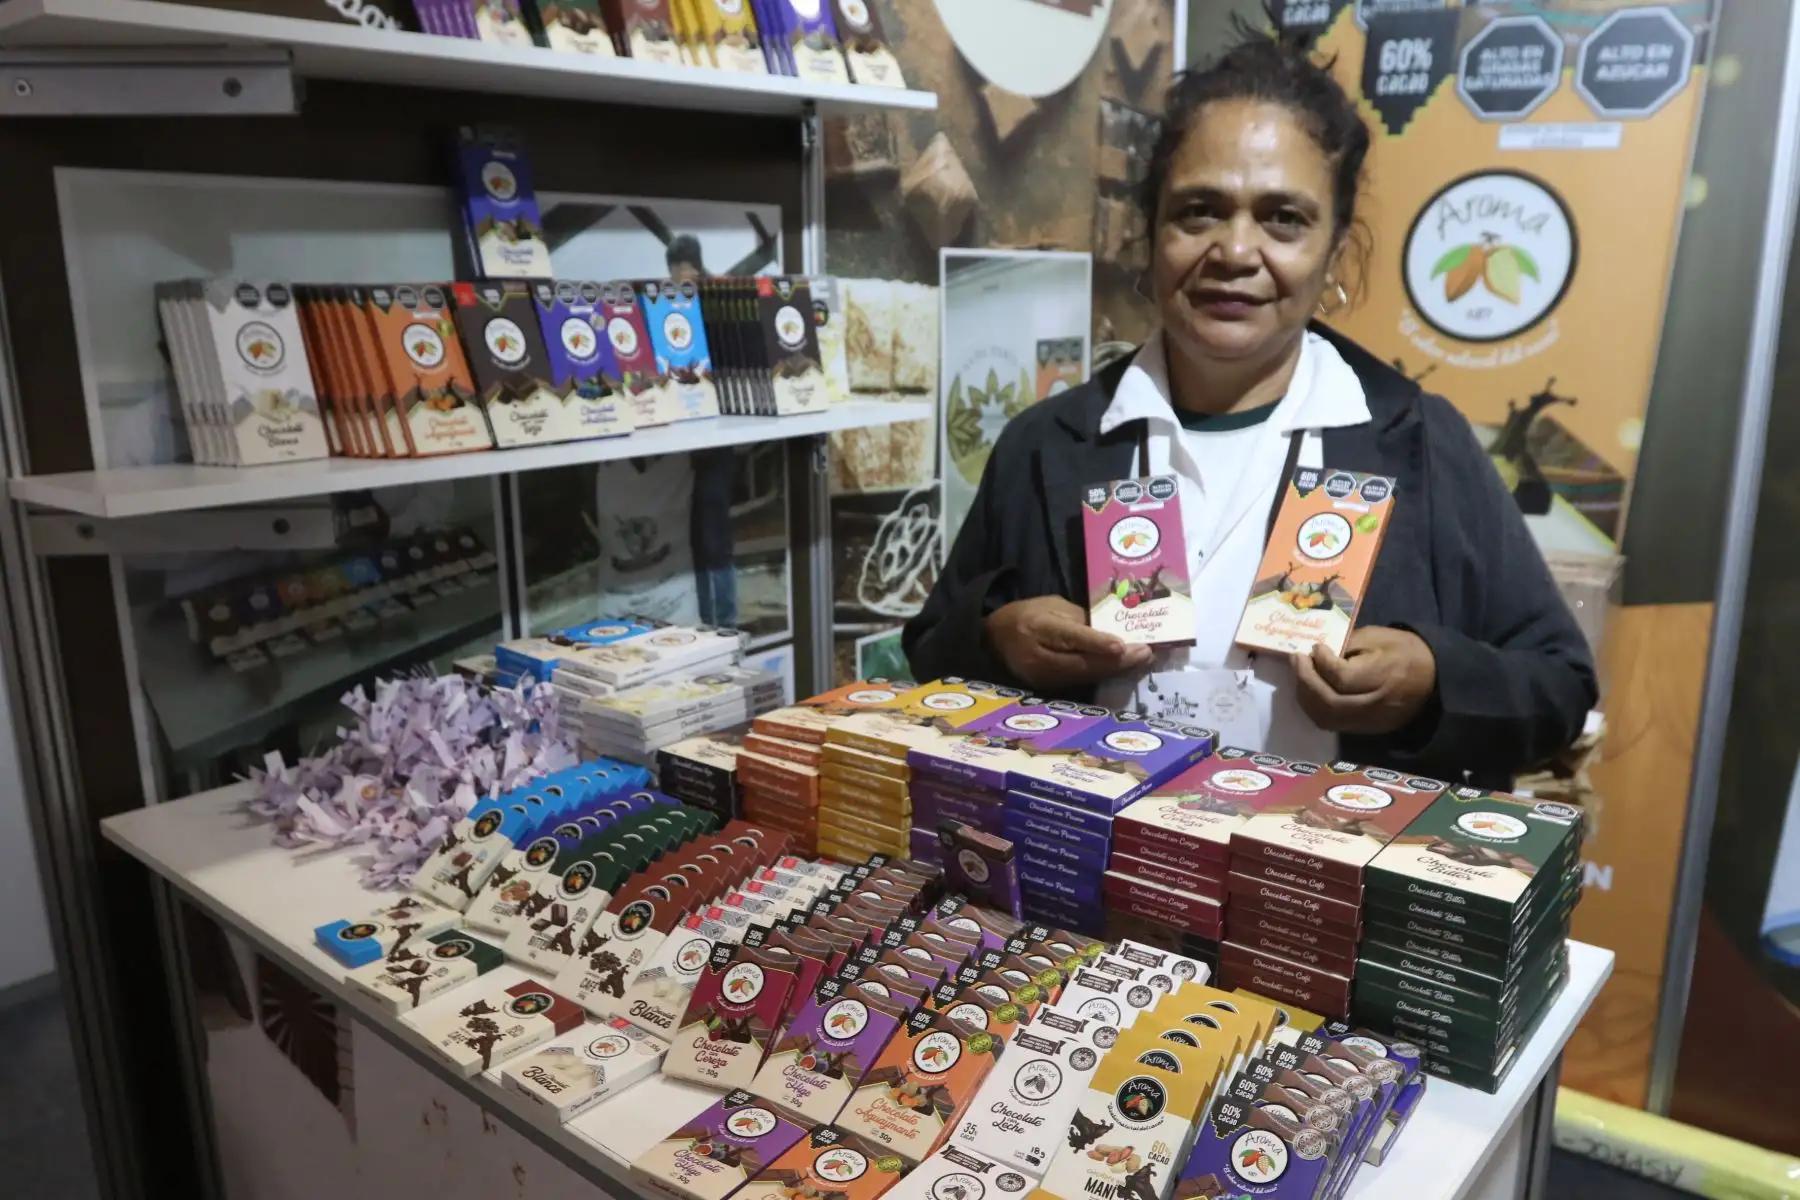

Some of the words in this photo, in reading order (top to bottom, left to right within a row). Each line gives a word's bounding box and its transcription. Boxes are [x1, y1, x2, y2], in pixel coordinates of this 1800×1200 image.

[1379, 38, 1433, 72] 60%
[1598, 46, 1643, 61] ALTO
[1437, 194, 1551, 241] Aroma
[1264, 847, 1294, 861] Chocolate
[1265, 867, 1296, 881] Chocolate
[1260, 887, 1290, 901] Chocolate
[1408, 883, 1443, 899] Chocolate
[749, 930, 764, 941] 50%
[715, 947, 732, 958] 50%
[985, 953, 1001, 964] 60%
[732, 964, 761, 980] Aroma
[963, 967, 978, 979] 60%
[823, 981, 840, 992] 50%
[939, 985, 957, 997] 60%
[629, 999, 673, 1029] Blanco
[836, 1001, 865, 1017] Aroma
[1396, 1000, 1430, 1017] Chocolate
[915, 1012, 932, 1023] 60%
[692, 1036, 742, 1057] Chocolate
[928, 1034, 958, 1051] Aroma
[1305, 1037, 1324, 1050] 60%
[694, 1050, 728, 1069] Cereza
[1279, 1051, 1299, 1064] 60%
[782, 1064, 831, 1089] Chocolate
[1028, 1063, 1057, 1079] Aroma
[1255, 1064, 1275, 1078] 60%
[522, 1065, 563, 1094] Blanco
[1239, 1078, 1258, 1094] 60%
[1128, 1081, 1161, 1099] Aroma
[1235, 1089, 1254, 1100] cacao
[871, 1097, 922, 1125] Chocolate
[991, 1101, 1046, 1127] Chocolate
[1221, 1103, 1242, 1119] 60%
[992, 1116, 1025, 1134] Leche
[1218, 1113, 1238, 1126] cacao
[879, 1132, 892, 1144] 30g
[1245, 1133, 1284, 1156] Aroma
[1147, 1151, 1170, 1165] CACAO
